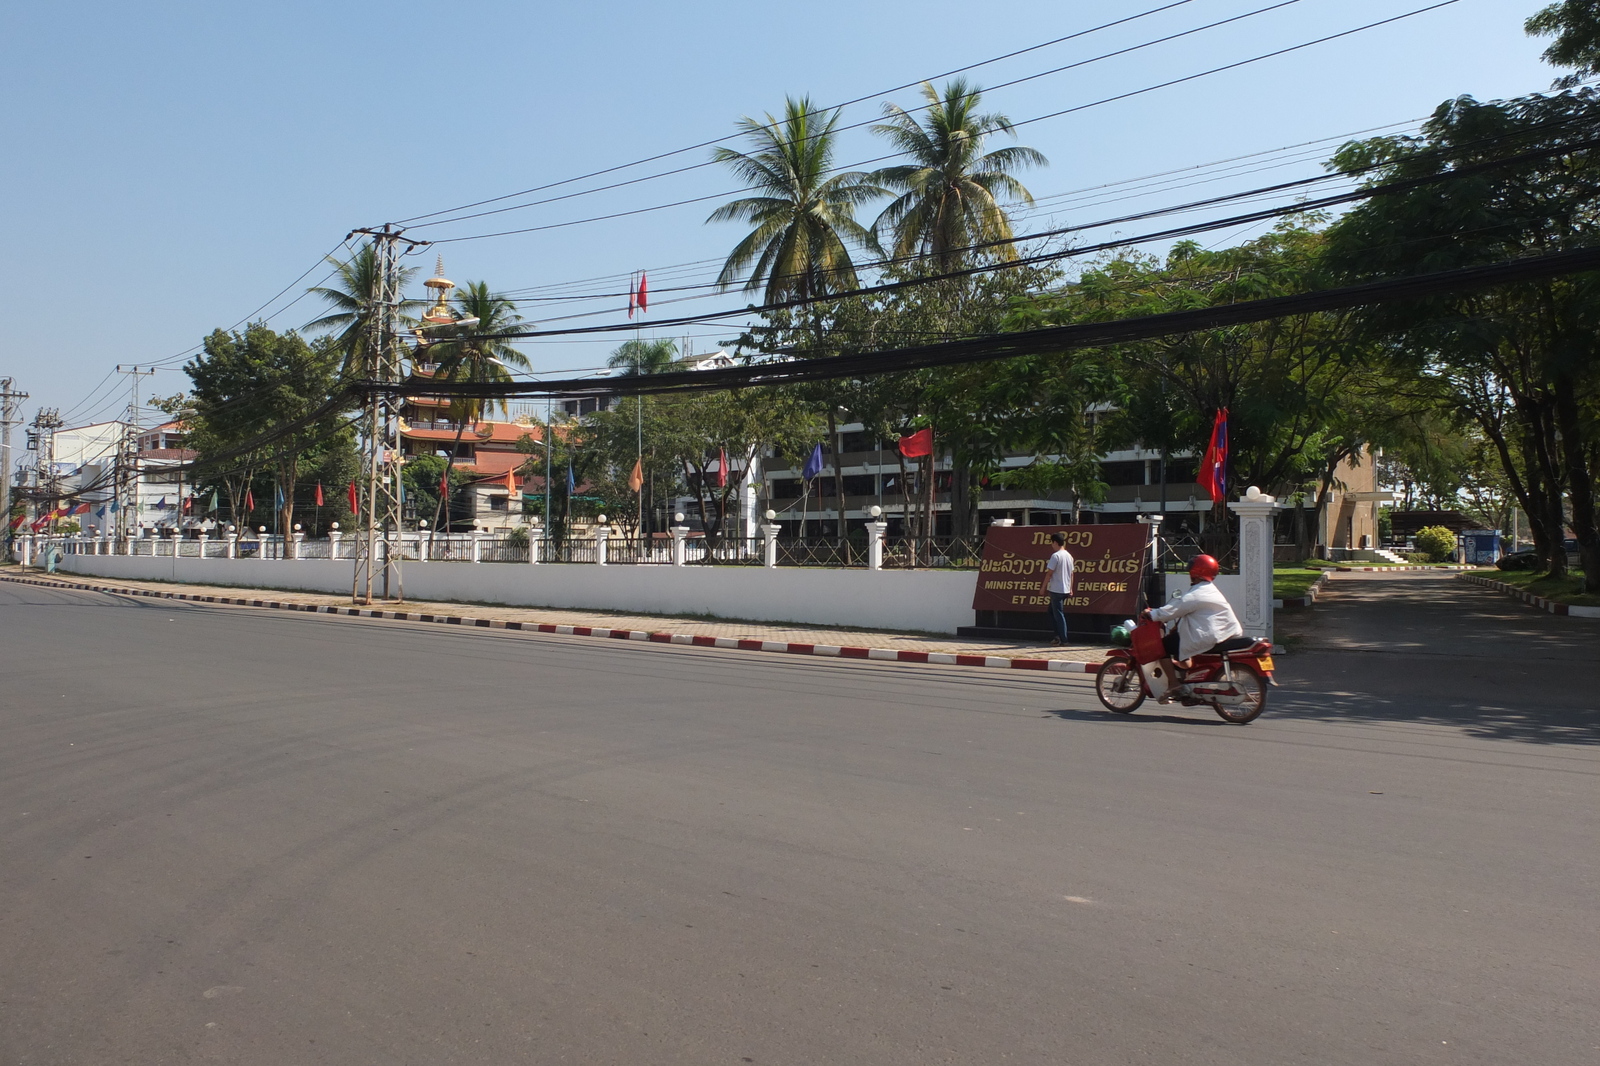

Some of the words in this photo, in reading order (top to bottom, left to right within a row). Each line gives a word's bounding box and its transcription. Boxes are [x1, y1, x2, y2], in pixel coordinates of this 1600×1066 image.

[1012, 596, 1026, 605] ET
[1029, 596, 1051, 605] DES
[1064, 597, 1090, 606] INES
